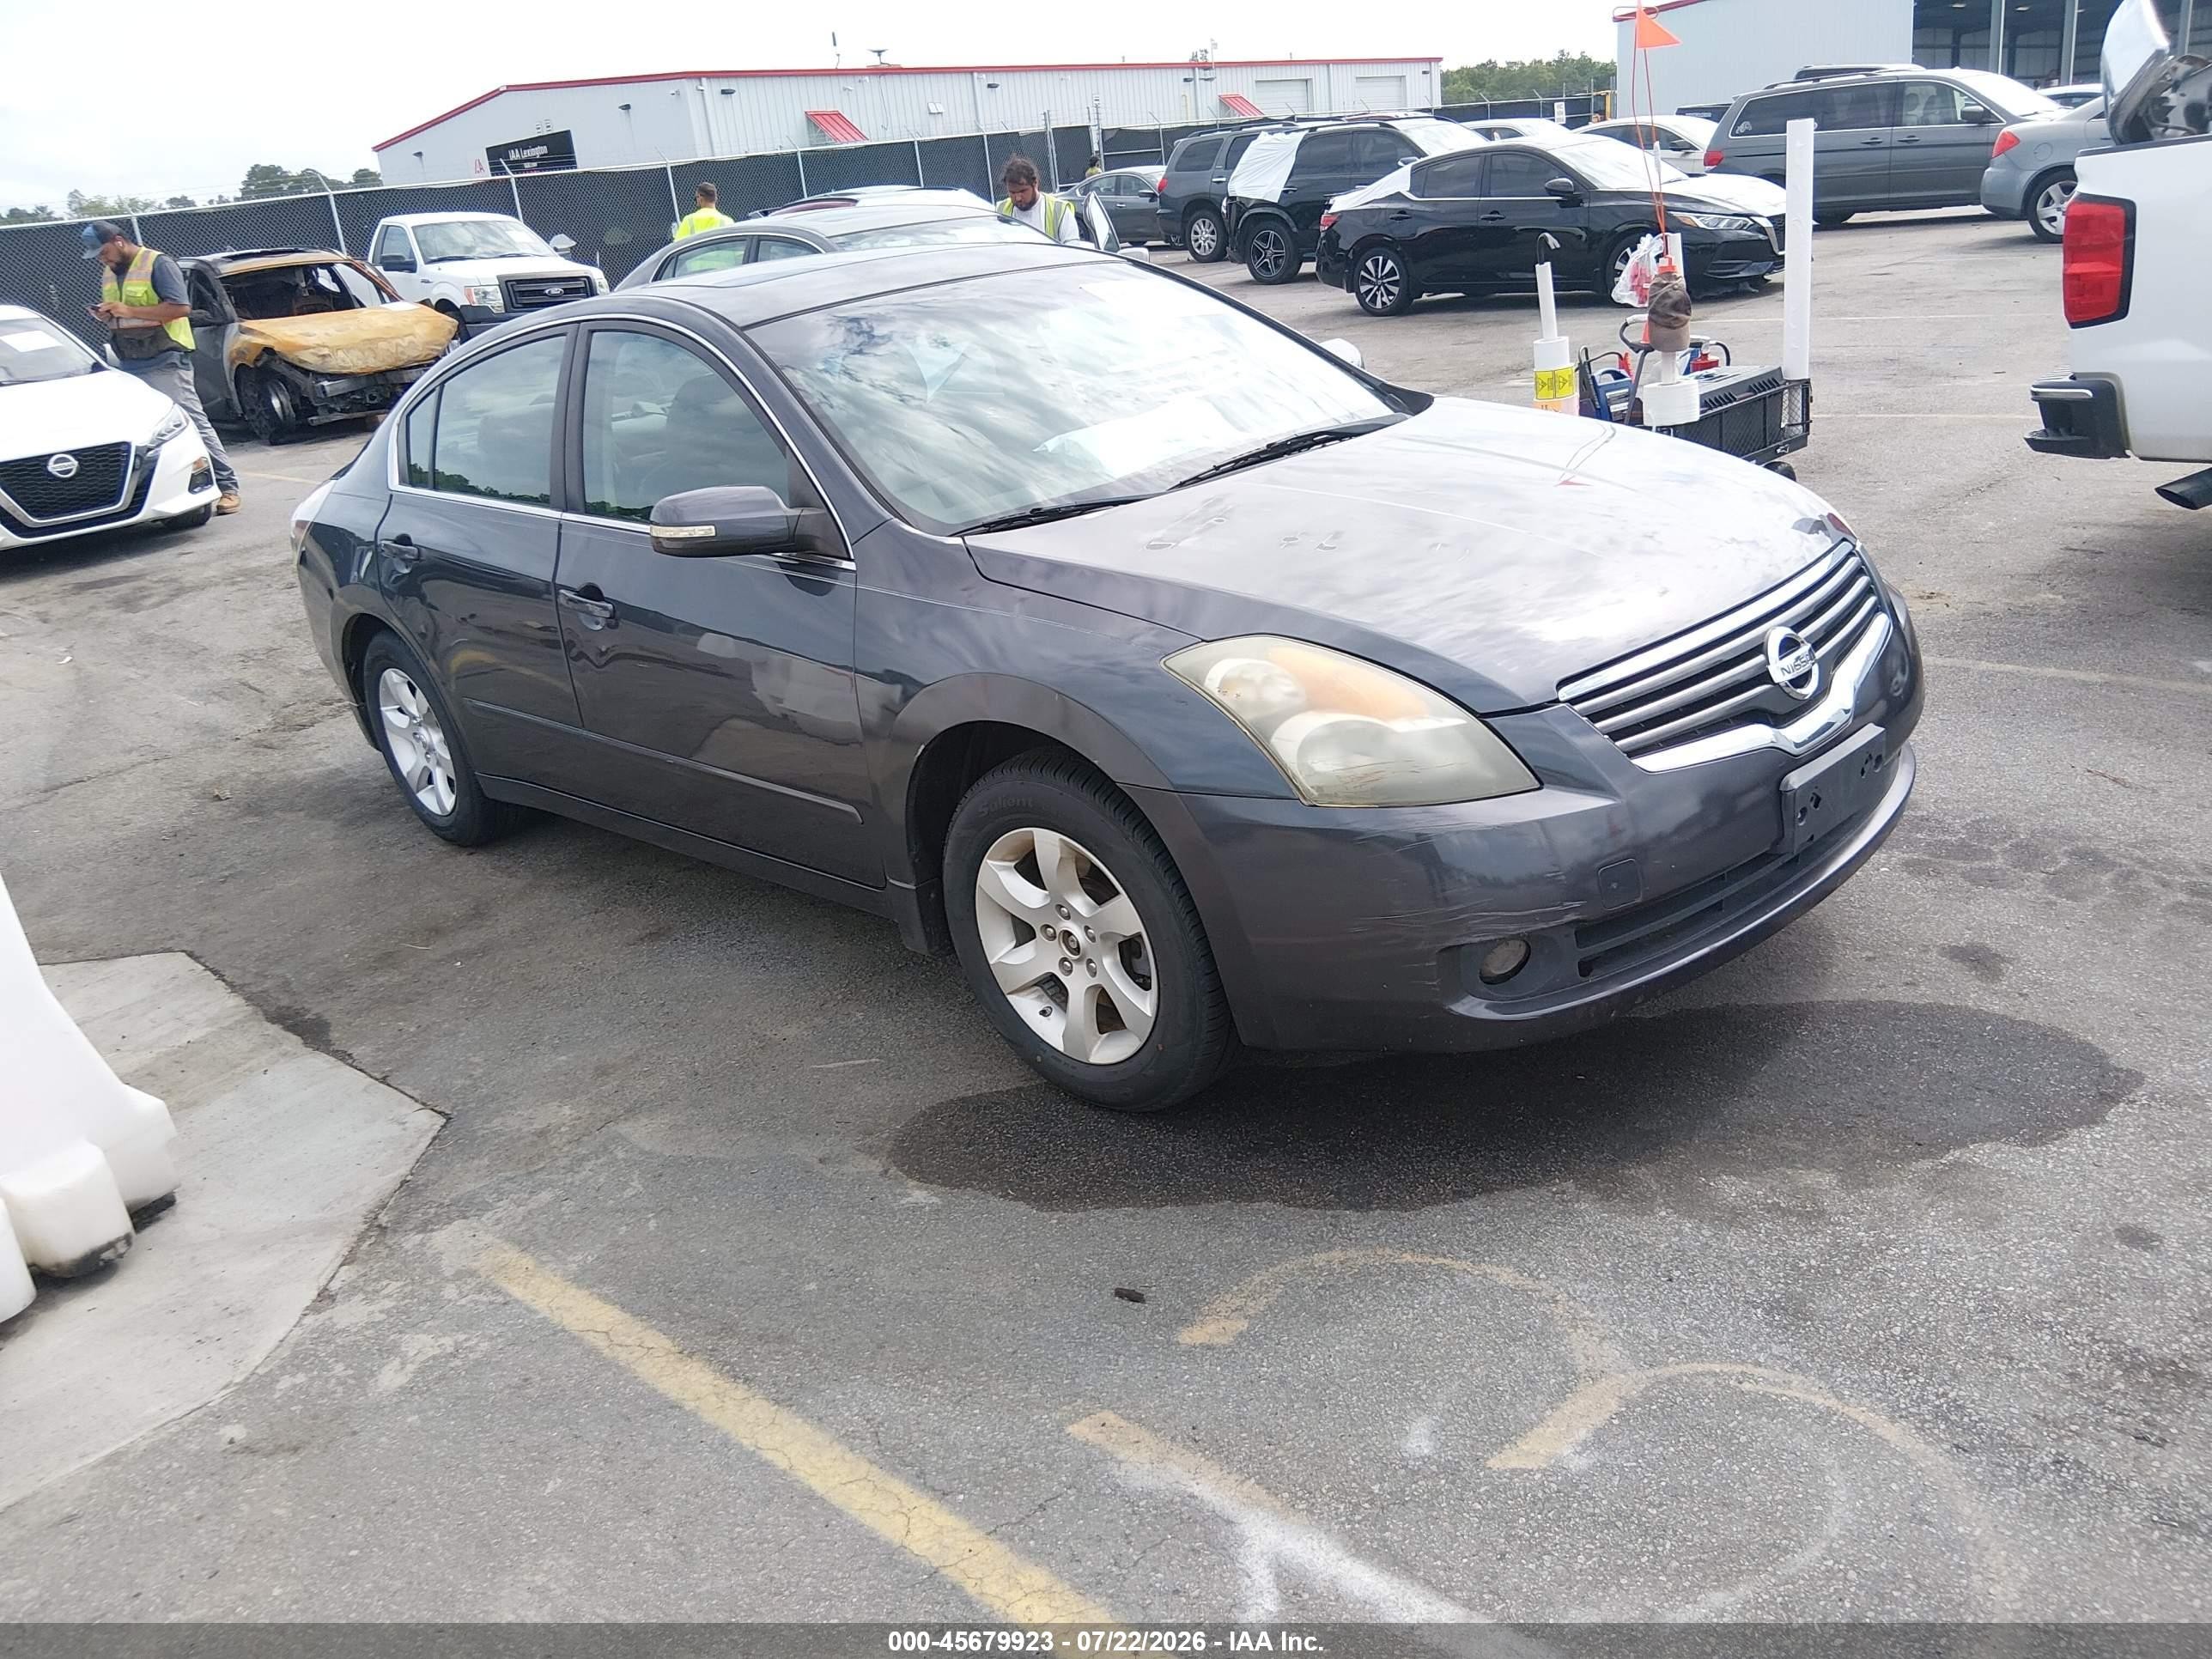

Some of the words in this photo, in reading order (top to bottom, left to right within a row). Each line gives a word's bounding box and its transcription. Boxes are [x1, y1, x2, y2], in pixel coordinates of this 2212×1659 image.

[507, 148, 520, 161] IAA
[520, 145, 549, 159] Lexington
[1780, 650, 1814, 677] NISSA
